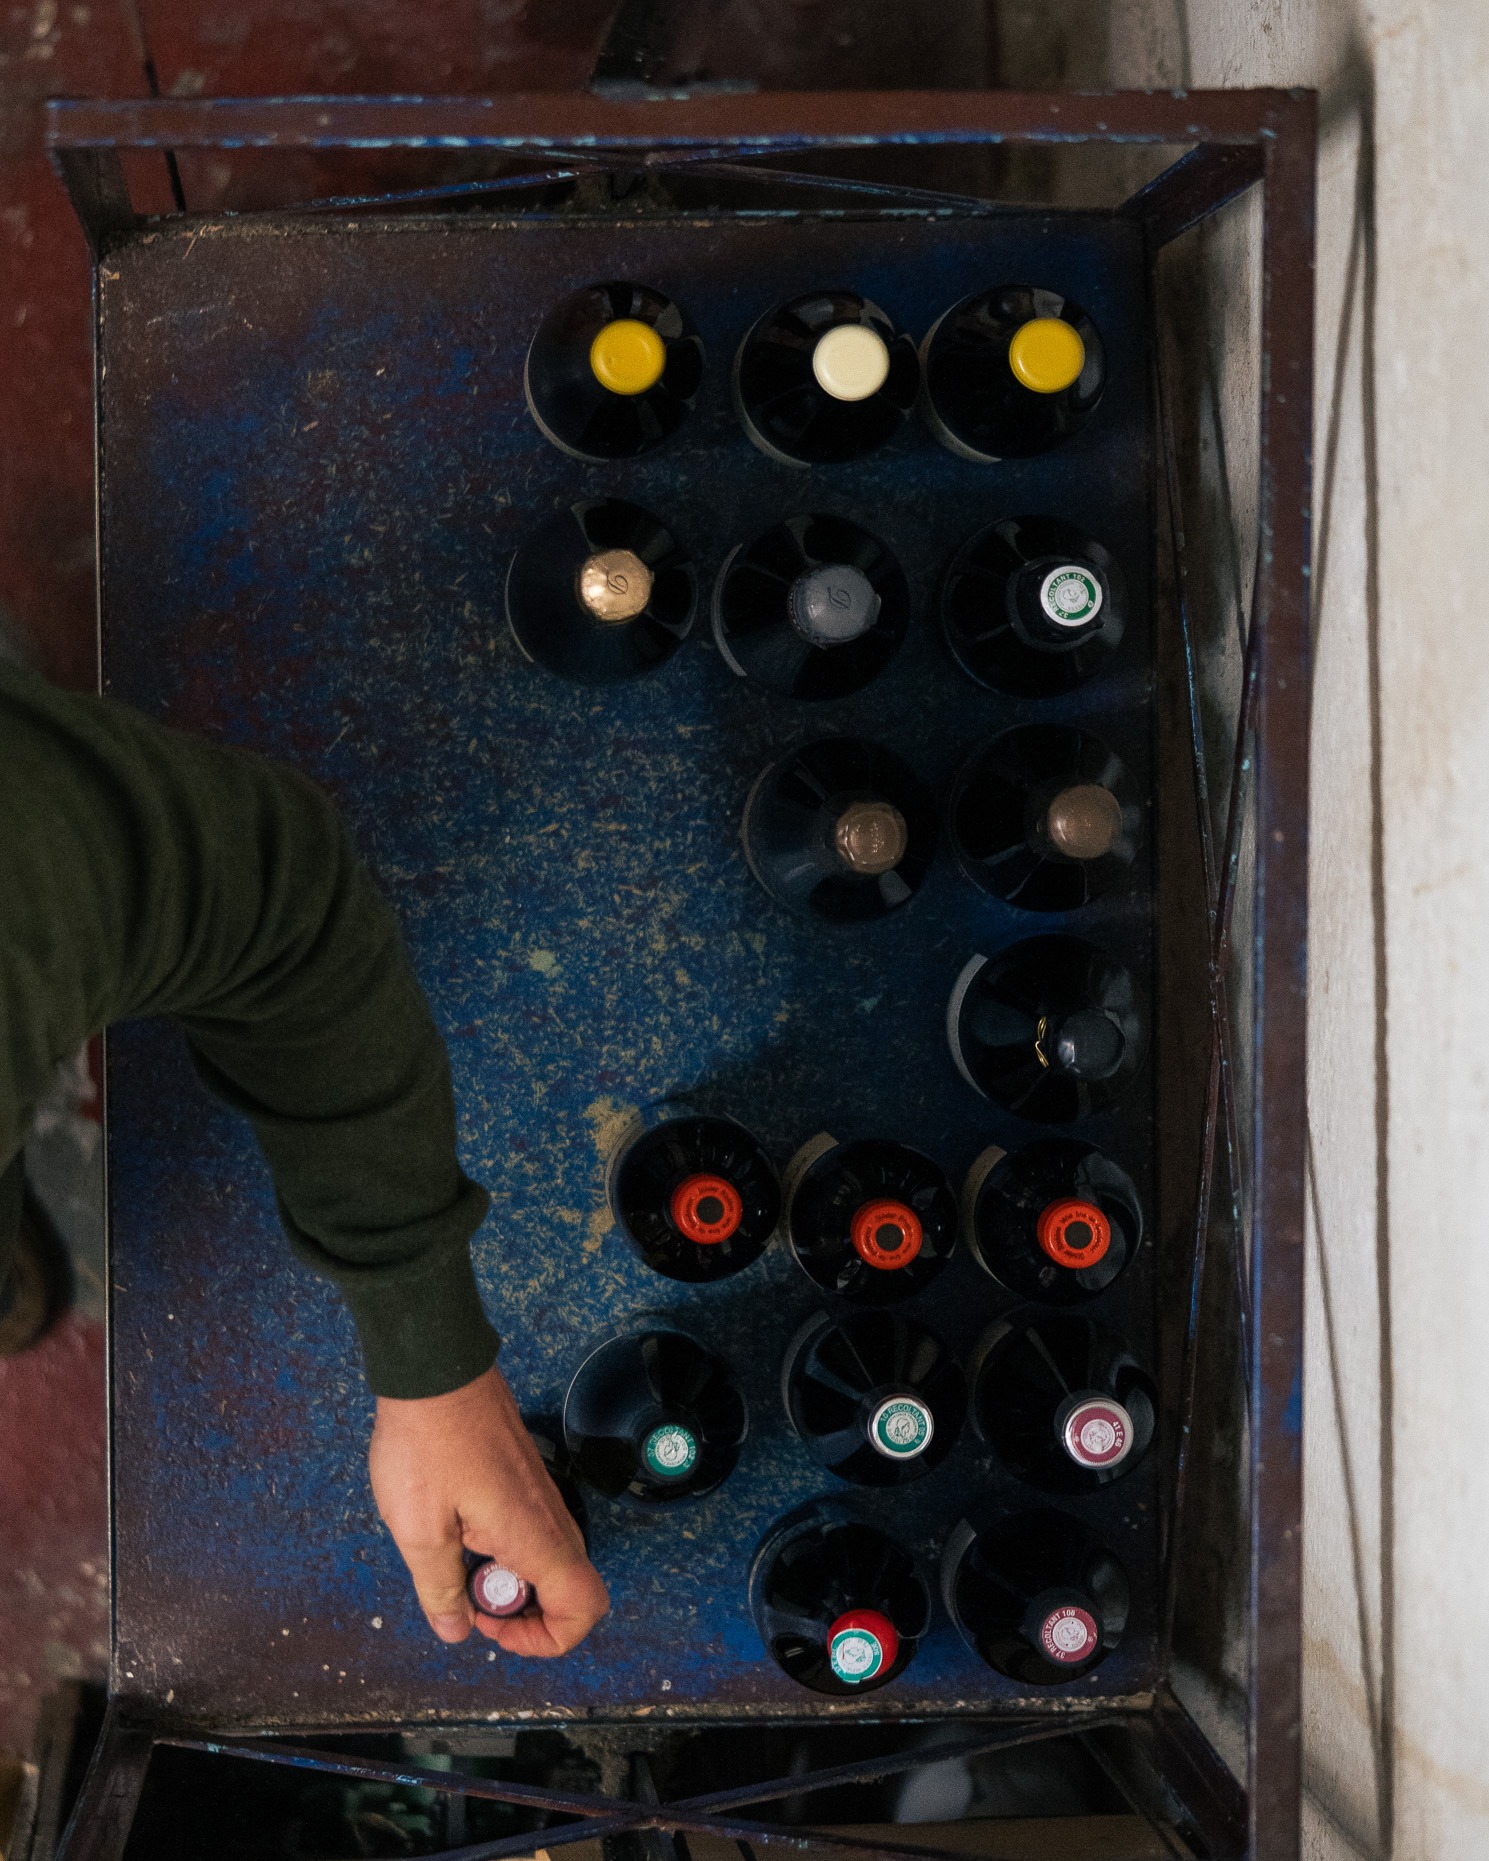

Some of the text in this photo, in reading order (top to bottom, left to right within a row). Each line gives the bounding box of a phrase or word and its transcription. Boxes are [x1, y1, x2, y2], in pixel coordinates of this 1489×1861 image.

[1048, 572, 1086, 619] 37 RECOLTANT 102
[886, 1403, 926, 1425] RECOLTANT
[1111, 1419, 1121, 1430] 41
[1044, 1611, 1061, 1653] RECOLTANT
[1055, 1649, 1066, 1659] 37
